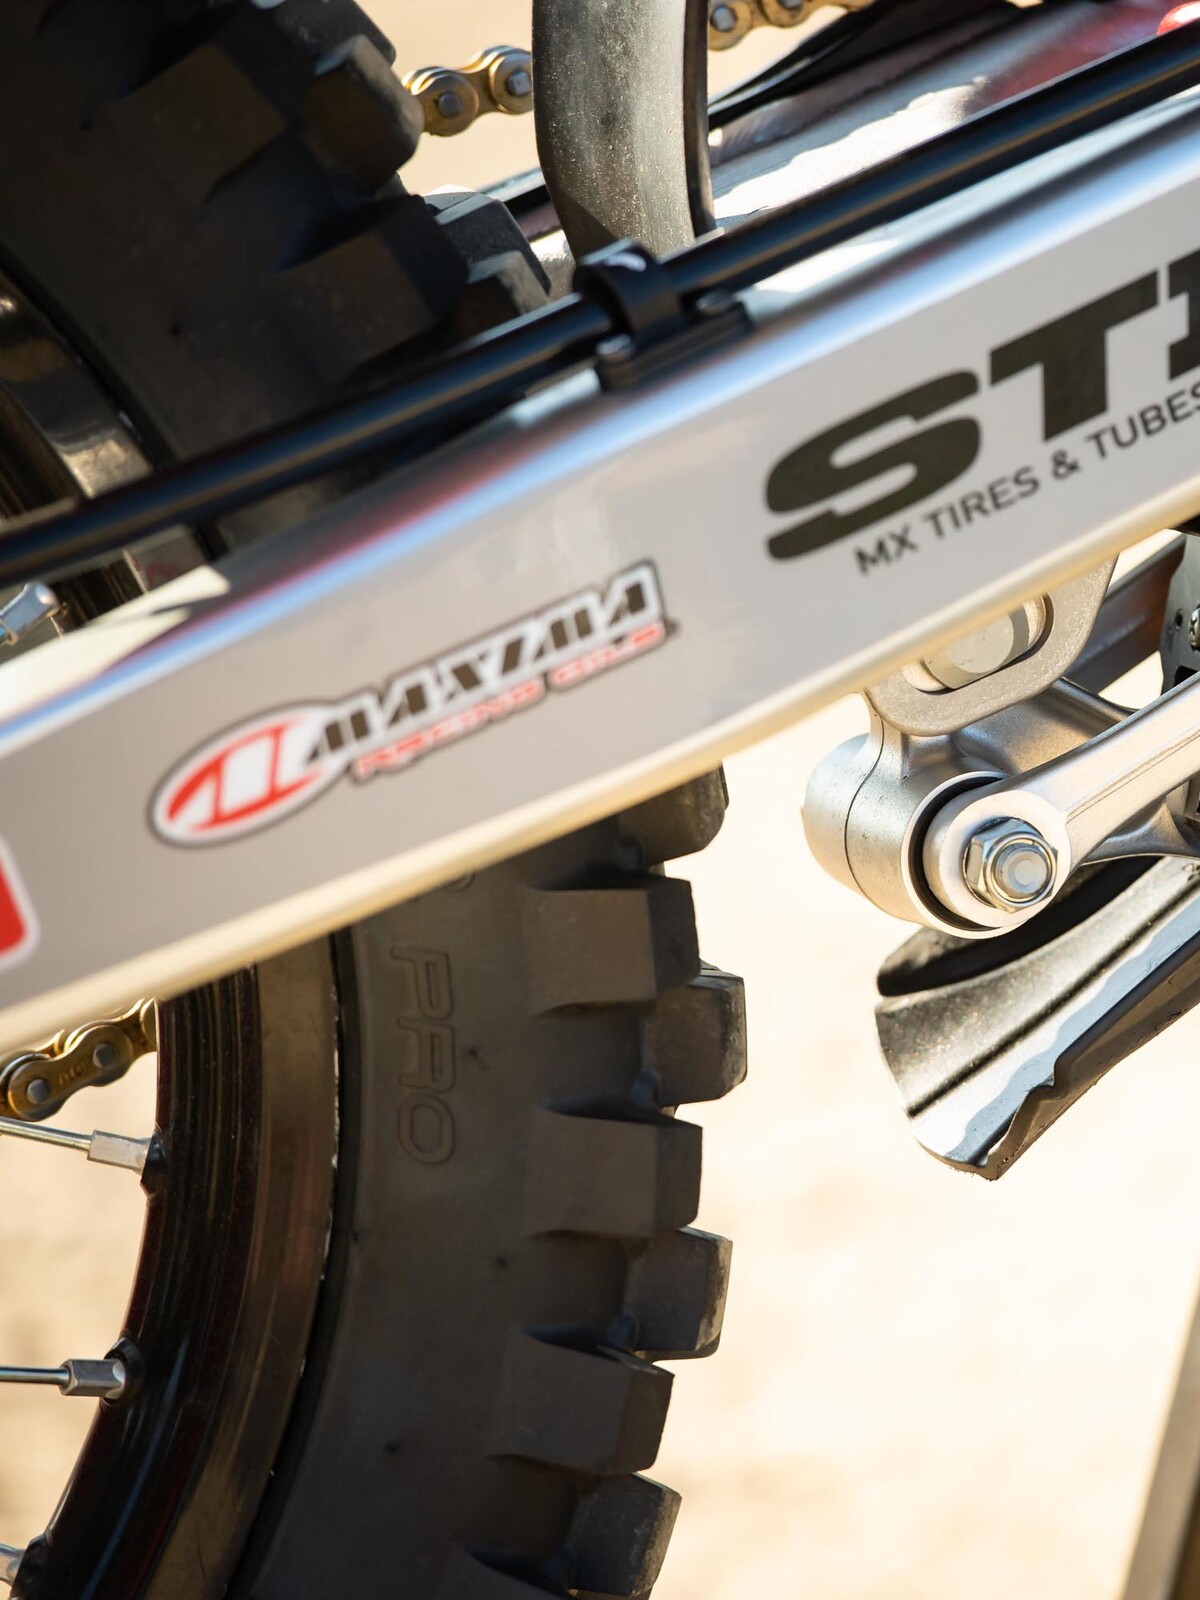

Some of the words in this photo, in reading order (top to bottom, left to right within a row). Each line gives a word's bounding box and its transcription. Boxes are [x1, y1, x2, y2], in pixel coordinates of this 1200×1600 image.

[854, 525, 920, 577] MX
[923, 466, 1041, 540] TIRES
[1051, 448, 1080, 481] &
[391, 945, 457, 1165] PRO
